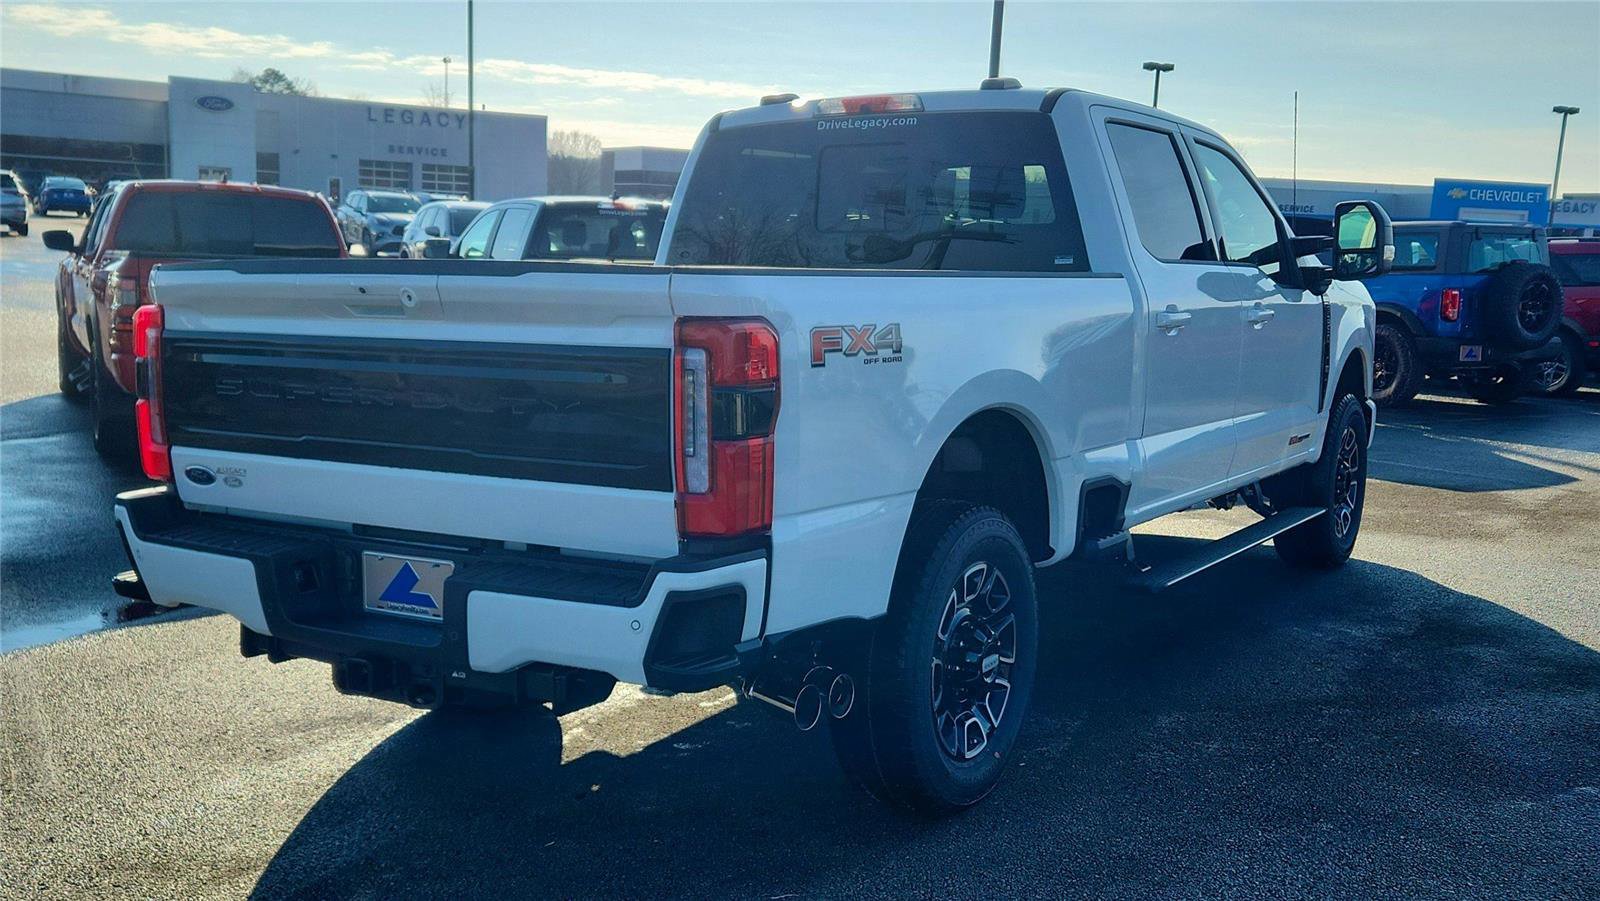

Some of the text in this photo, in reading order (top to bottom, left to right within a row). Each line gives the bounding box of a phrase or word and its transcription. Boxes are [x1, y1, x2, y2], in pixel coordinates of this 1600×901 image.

[367, 106, 466, 129] LEGACY
[817, 116, 918, 131] DriveLegacy.com
[388, 144, 448, 157] SERVICE
[1469, 188, 1543, 204] CHEVROLET
[1279, 204, 1315, 213] SERVICE
[809, 322, 903, 368] FX4
[863, 355, 903, 365] OFF ROAD
